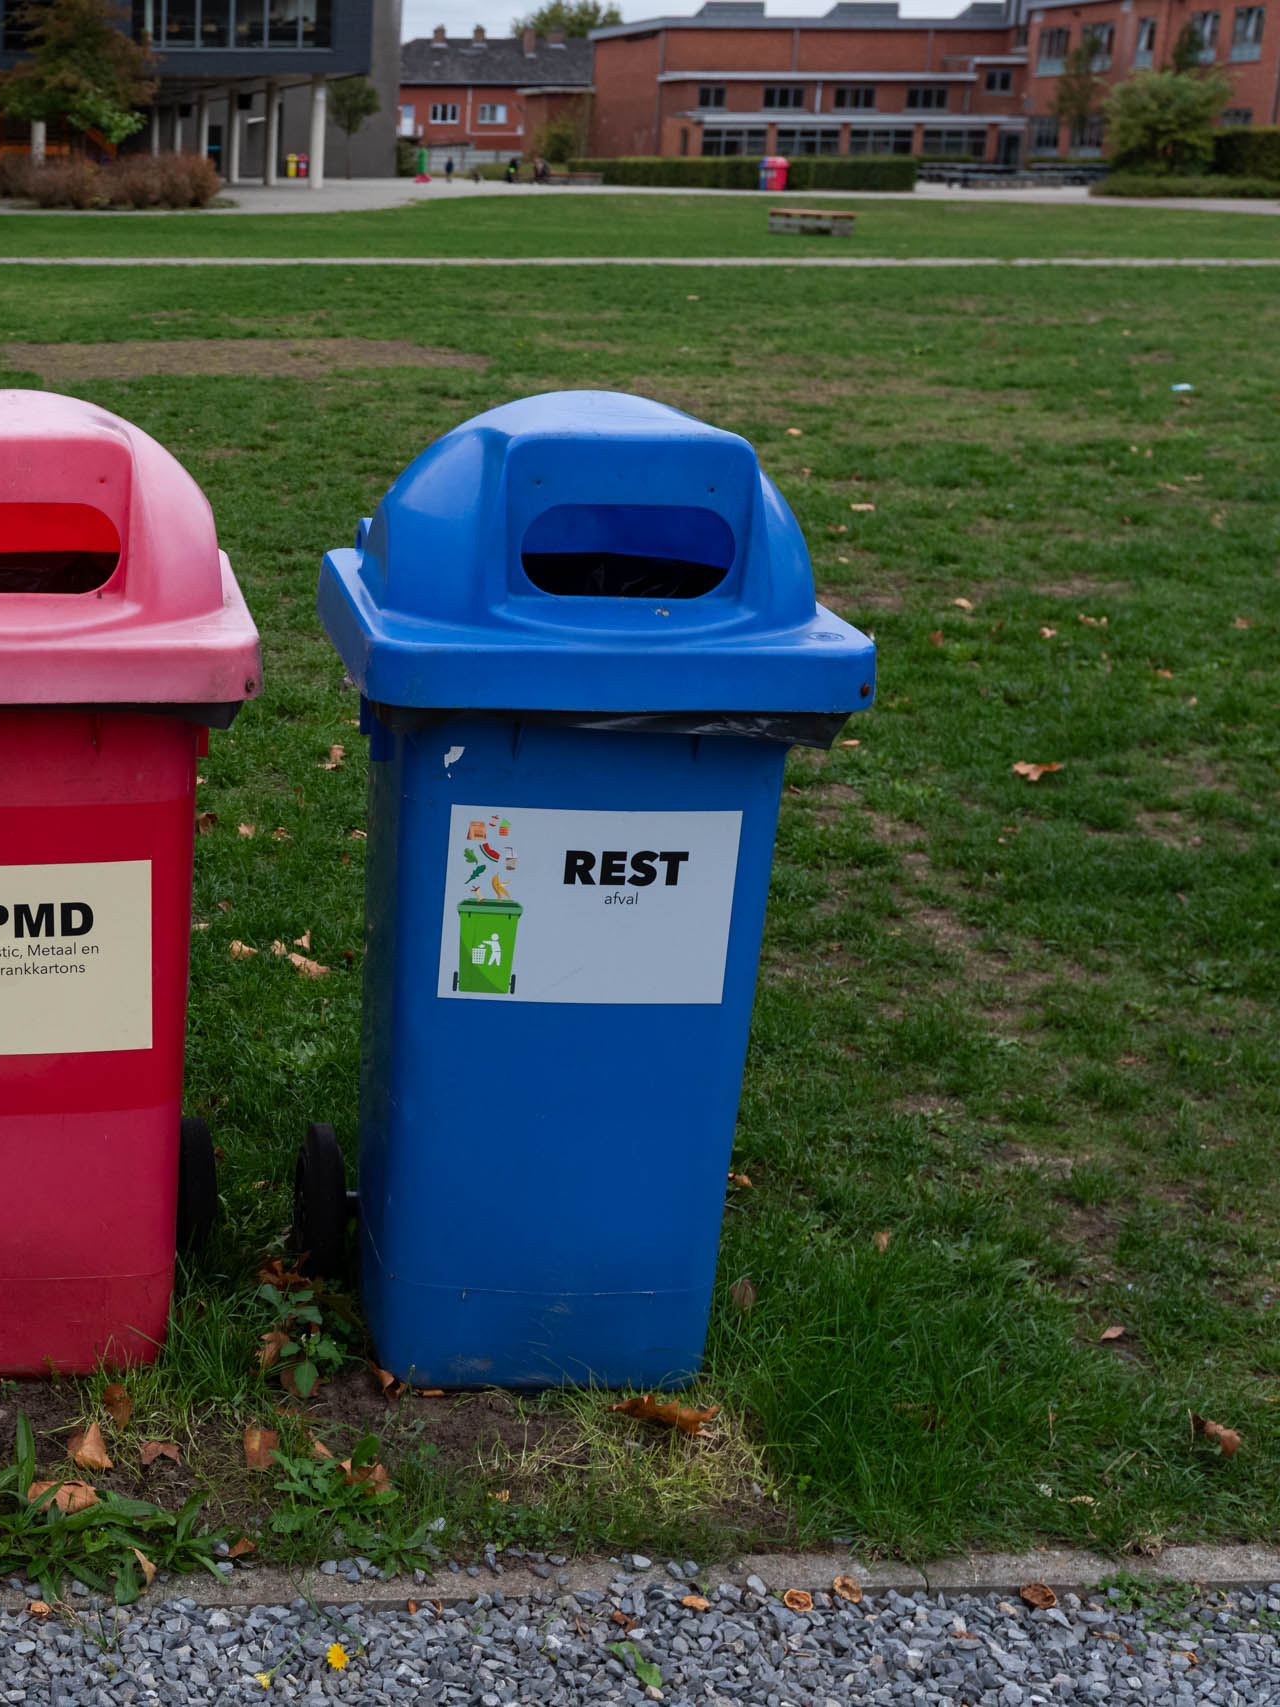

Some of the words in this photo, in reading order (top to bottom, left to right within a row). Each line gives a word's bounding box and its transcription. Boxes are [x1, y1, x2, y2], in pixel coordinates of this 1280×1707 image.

[563, 850, 690, 887] REST
[604, 892, 639, 905] afval
[28, 943, 77, 957] Metaal
[81, 944, 99, 955] en
